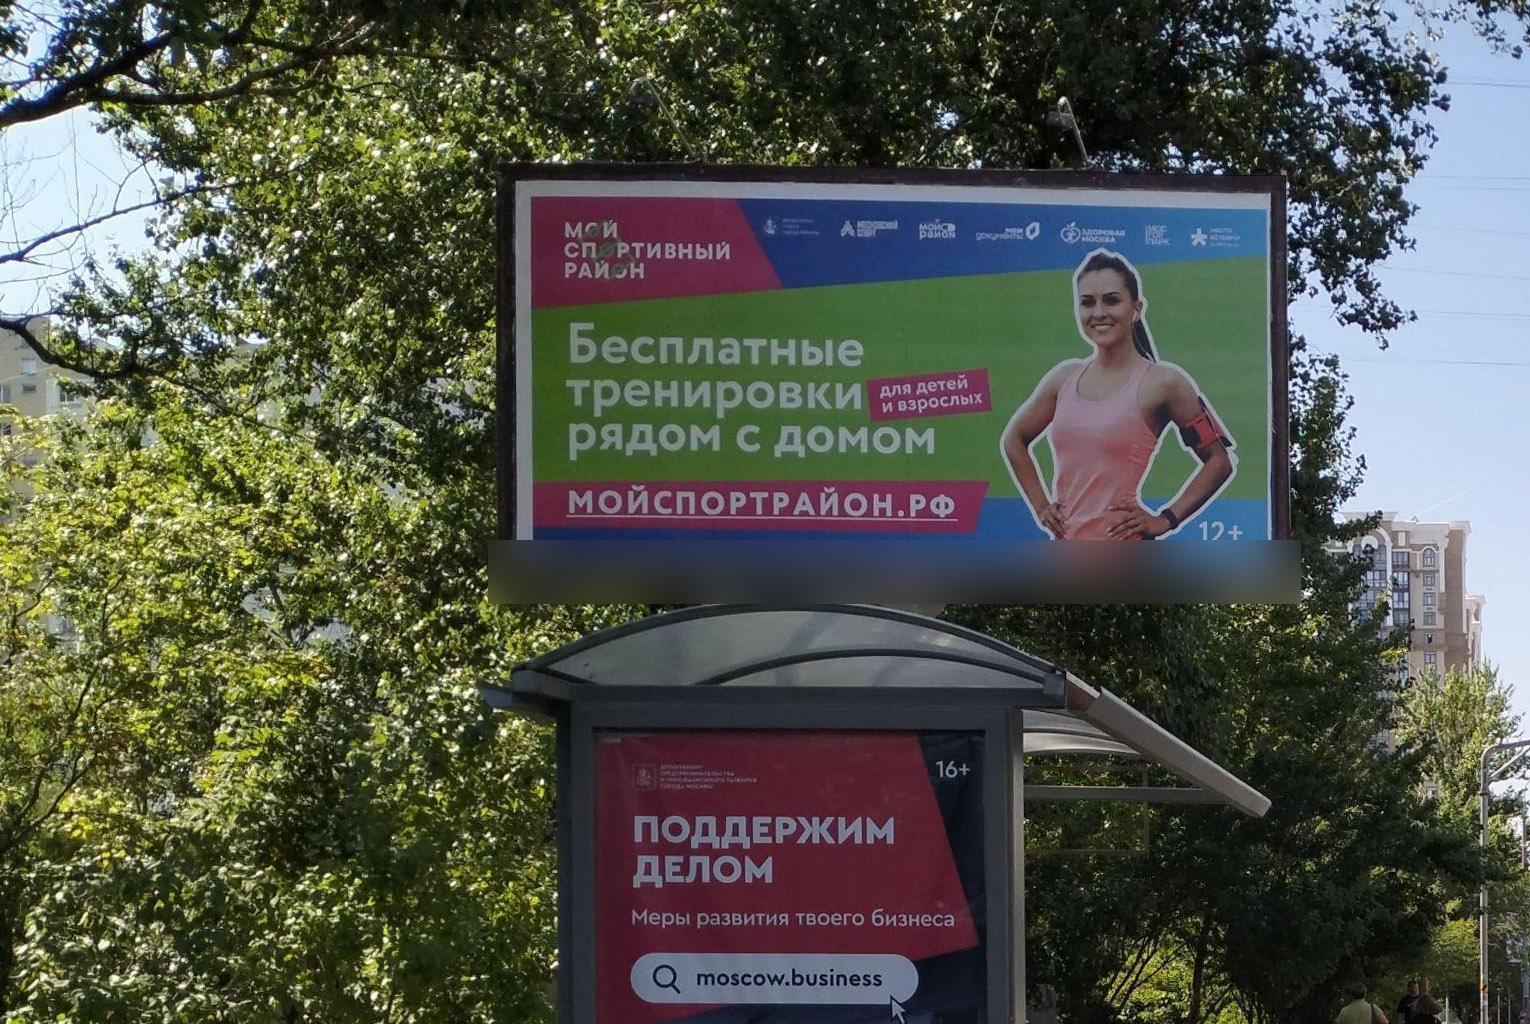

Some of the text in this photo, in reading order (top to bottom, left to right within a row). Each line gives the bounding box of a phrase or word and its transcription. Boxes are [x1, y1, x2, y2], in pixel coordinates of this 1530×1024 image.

[569, 322, 865, 367] Бесплатные
[566, 379, 862, 418] тренировки
[880, 374, 969, 399] для детей
[882, 393, 983, 413] и взрослых
[568, 422, 935, 461] рядом с домом
[568, 485, 956, 517] МОЙСПОРТРАЙОН.РФ
[1199, 520, 1243, 541] 12+
[936, 760, 971, 779] 16+
[633, 815, 895, 850] ПОДДЕРЖИМ
[632, 855, 774, 888] ДЕЛОМ
[632, 909, 955, 929] Меры развития твоего бизнеса
[696, 968, 883, 988] moscow.business
